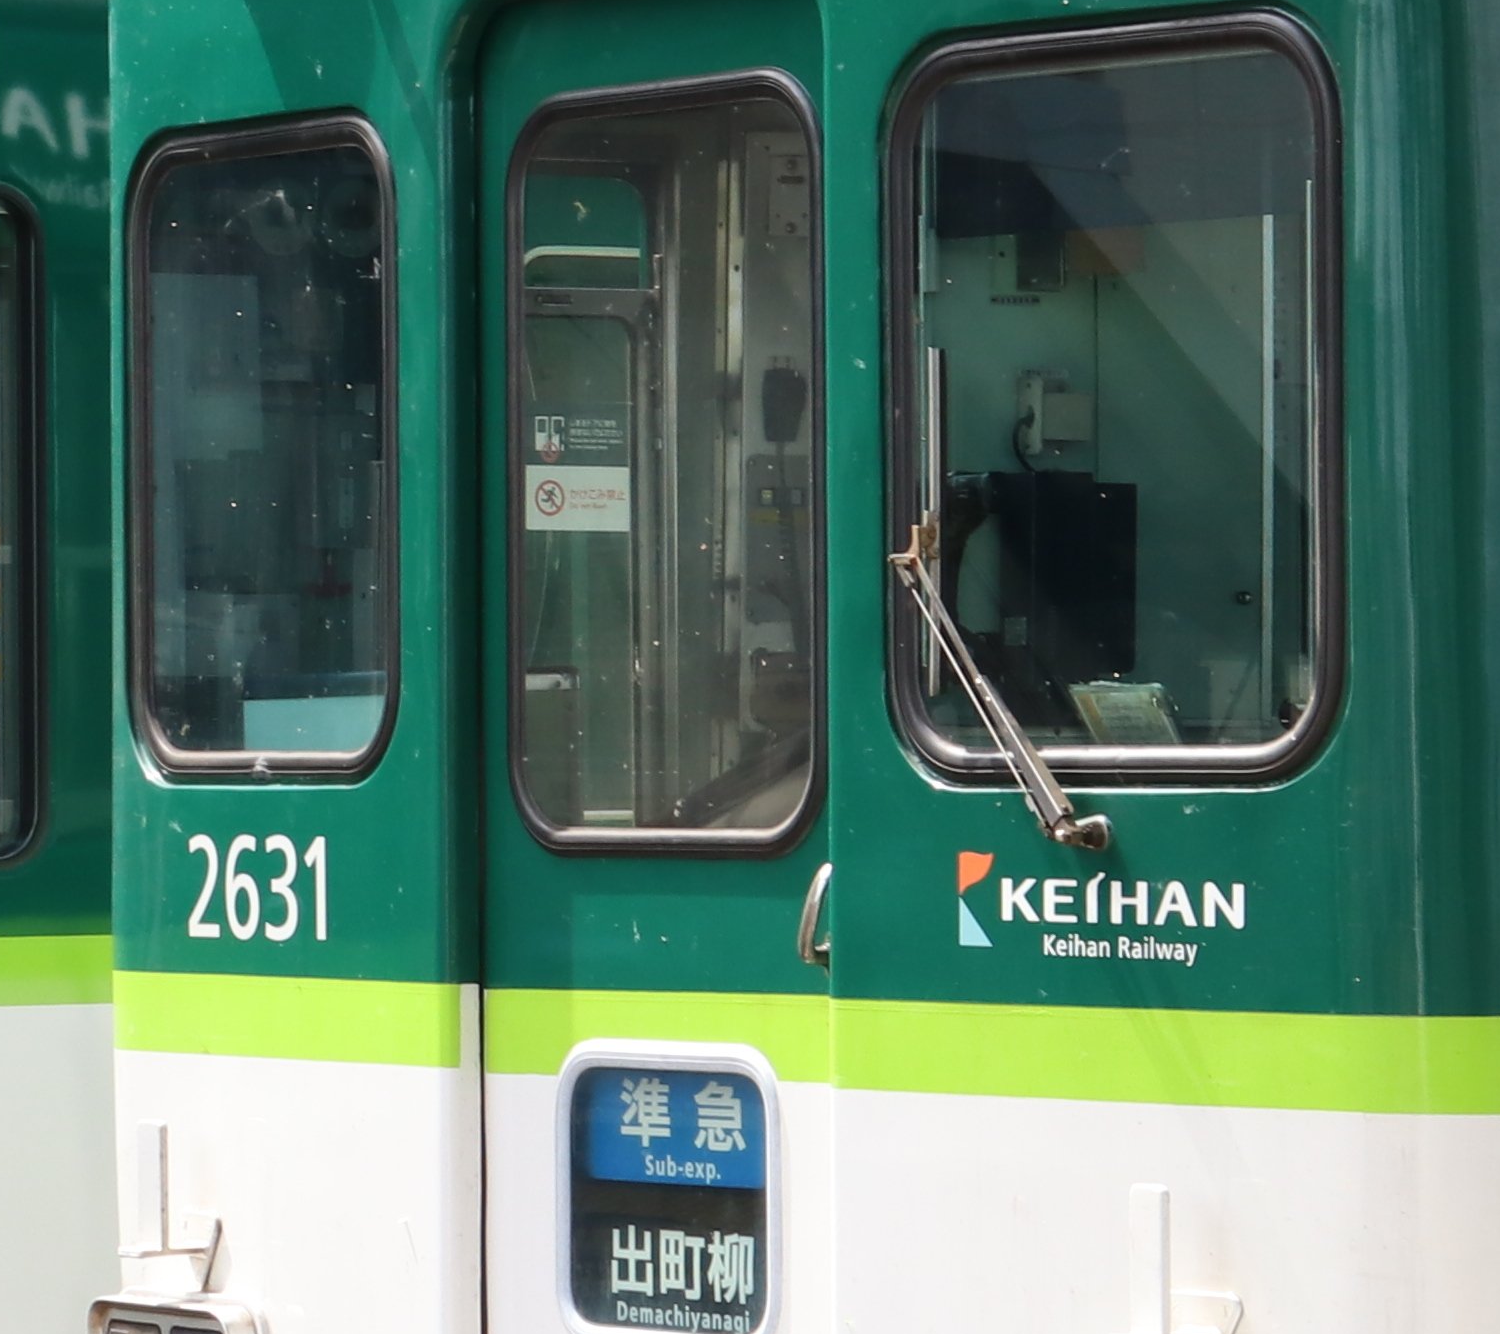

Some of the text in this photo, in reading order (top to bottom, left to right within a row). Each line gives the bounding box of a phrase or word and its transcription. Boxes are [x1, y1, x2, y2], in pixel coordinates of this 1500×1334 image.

[187, 832, 330, 943] 2631
[1001, 872, 1245, 929] KEIHAN
[1043, 934, 1198, 967] Keihan Railway
[620, 1078, 746, 1151] 準急
[645, 1155, 721, 1184] Sub-exp.
[610, 1225, 754, 1304] 出町柳
[616, 1301, 750, 1334] Demachiyanagi
